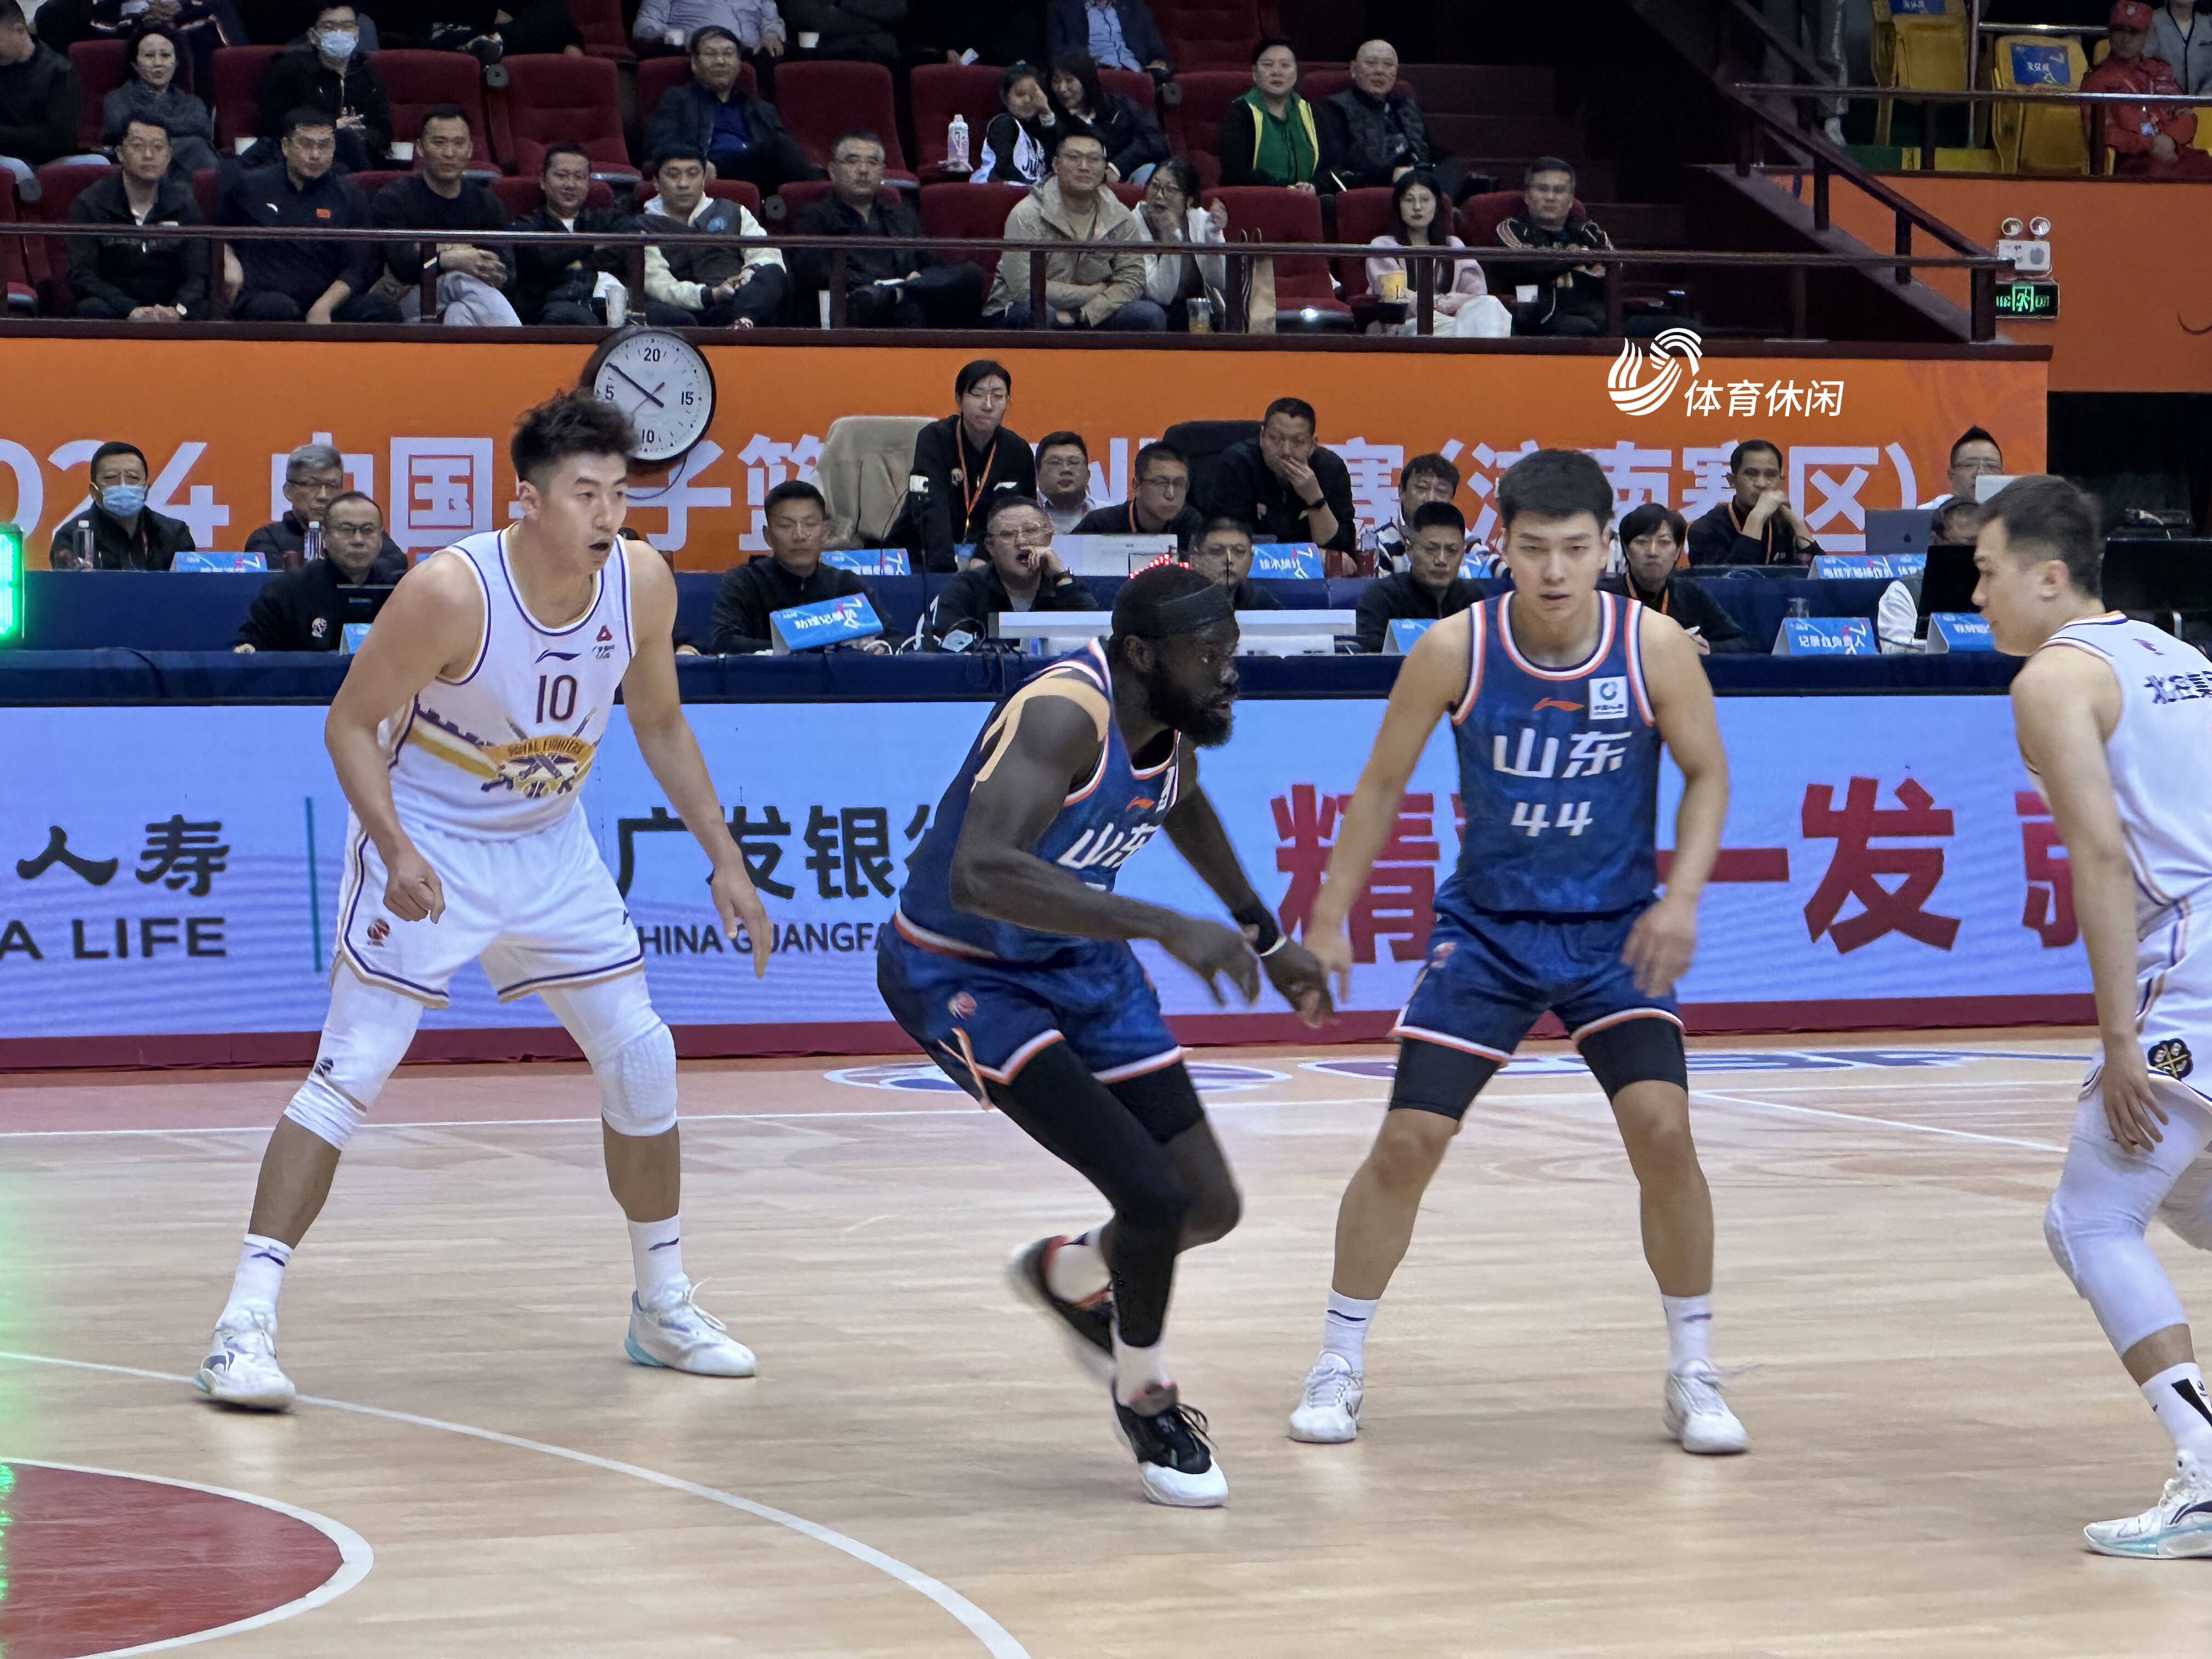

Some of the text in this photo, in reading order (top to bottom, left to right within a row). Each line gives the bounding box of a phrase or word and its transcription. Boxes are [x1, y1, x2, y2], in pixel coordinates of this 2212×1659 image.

[644, 347, 661, 362] 20
[681, 391, 694, 405] 15
[641, 429, 655, 443] 10
[537, 675, 577, 724] 10
[1493, 727, 1633, 778] 山东
[1510, 801, 1594, 837] 44
[618, 805, 932, 900] 广发银
[1270, 776, 1961, 964] 精一发
[72, 917, 226, 959] LIFE
[638, 924, 723, 955] HINA
